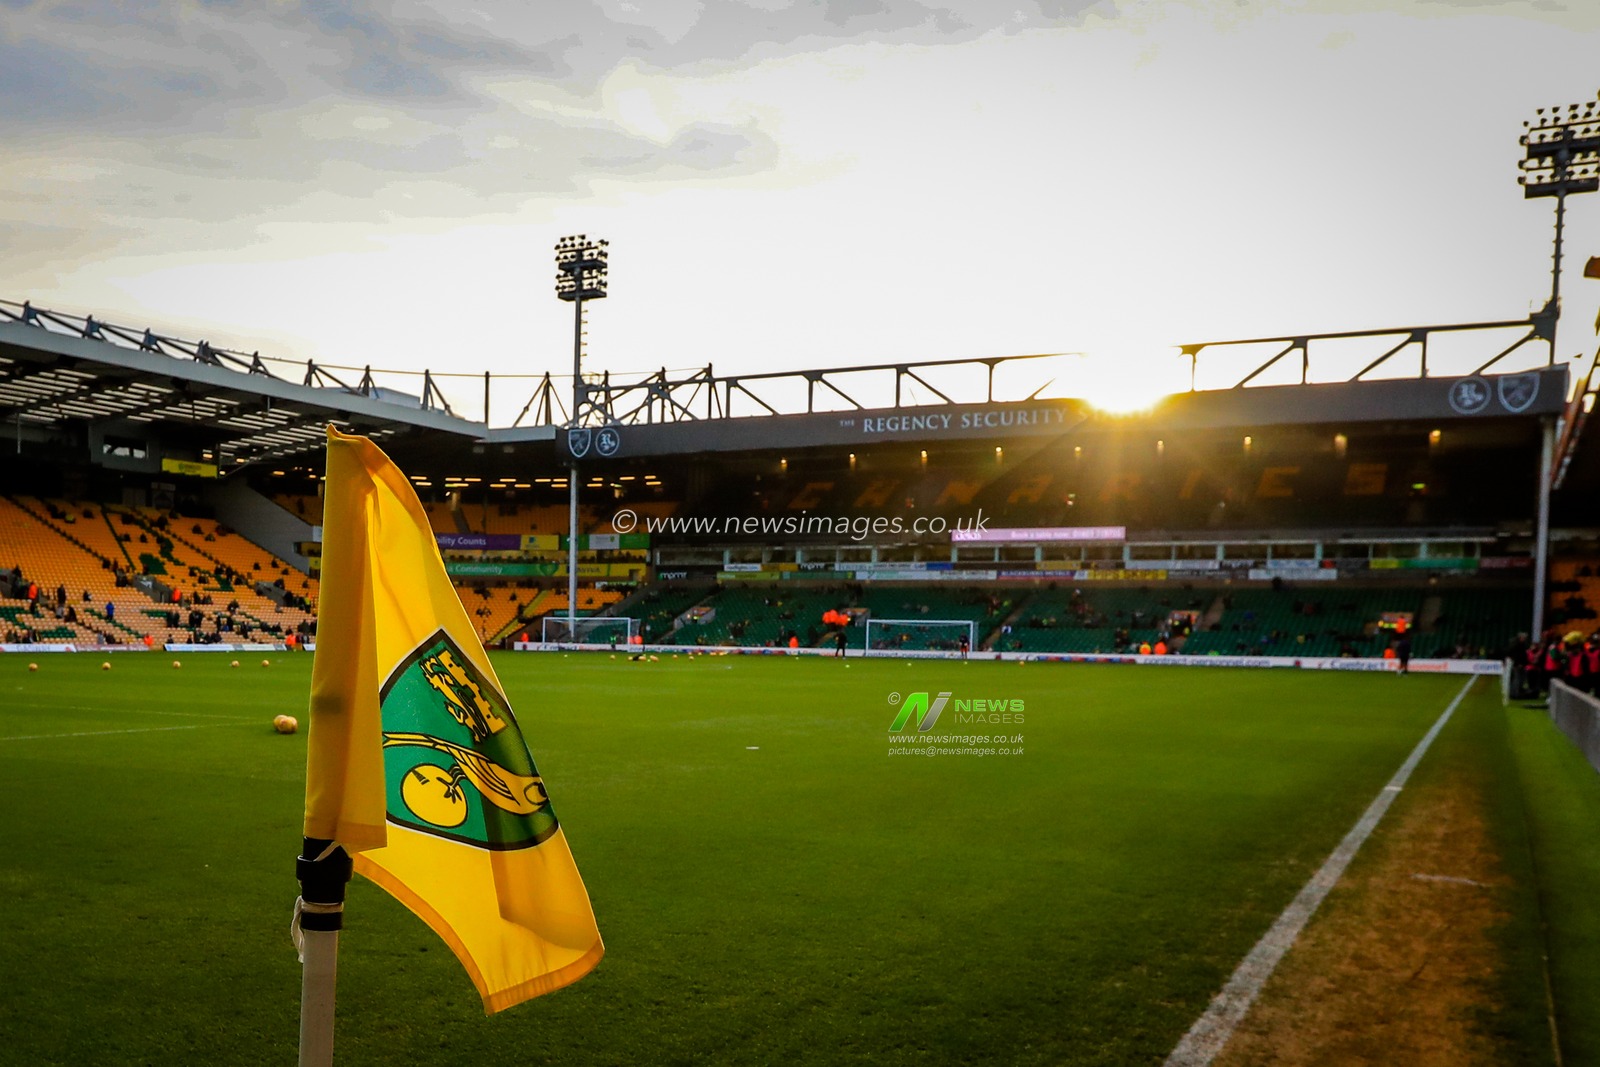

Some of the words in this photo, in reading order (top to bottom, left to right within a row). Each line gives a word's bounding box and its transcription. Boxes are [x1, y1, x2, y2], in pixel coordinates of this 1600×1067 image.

[840, 420, 855, 428] THE
[863, 413, 952, 433] REGENCY
[960, 407, 1068, 429] SECURITY
[457, 536, 487, 546] Counts
[455, 563, 503, 575] Community
